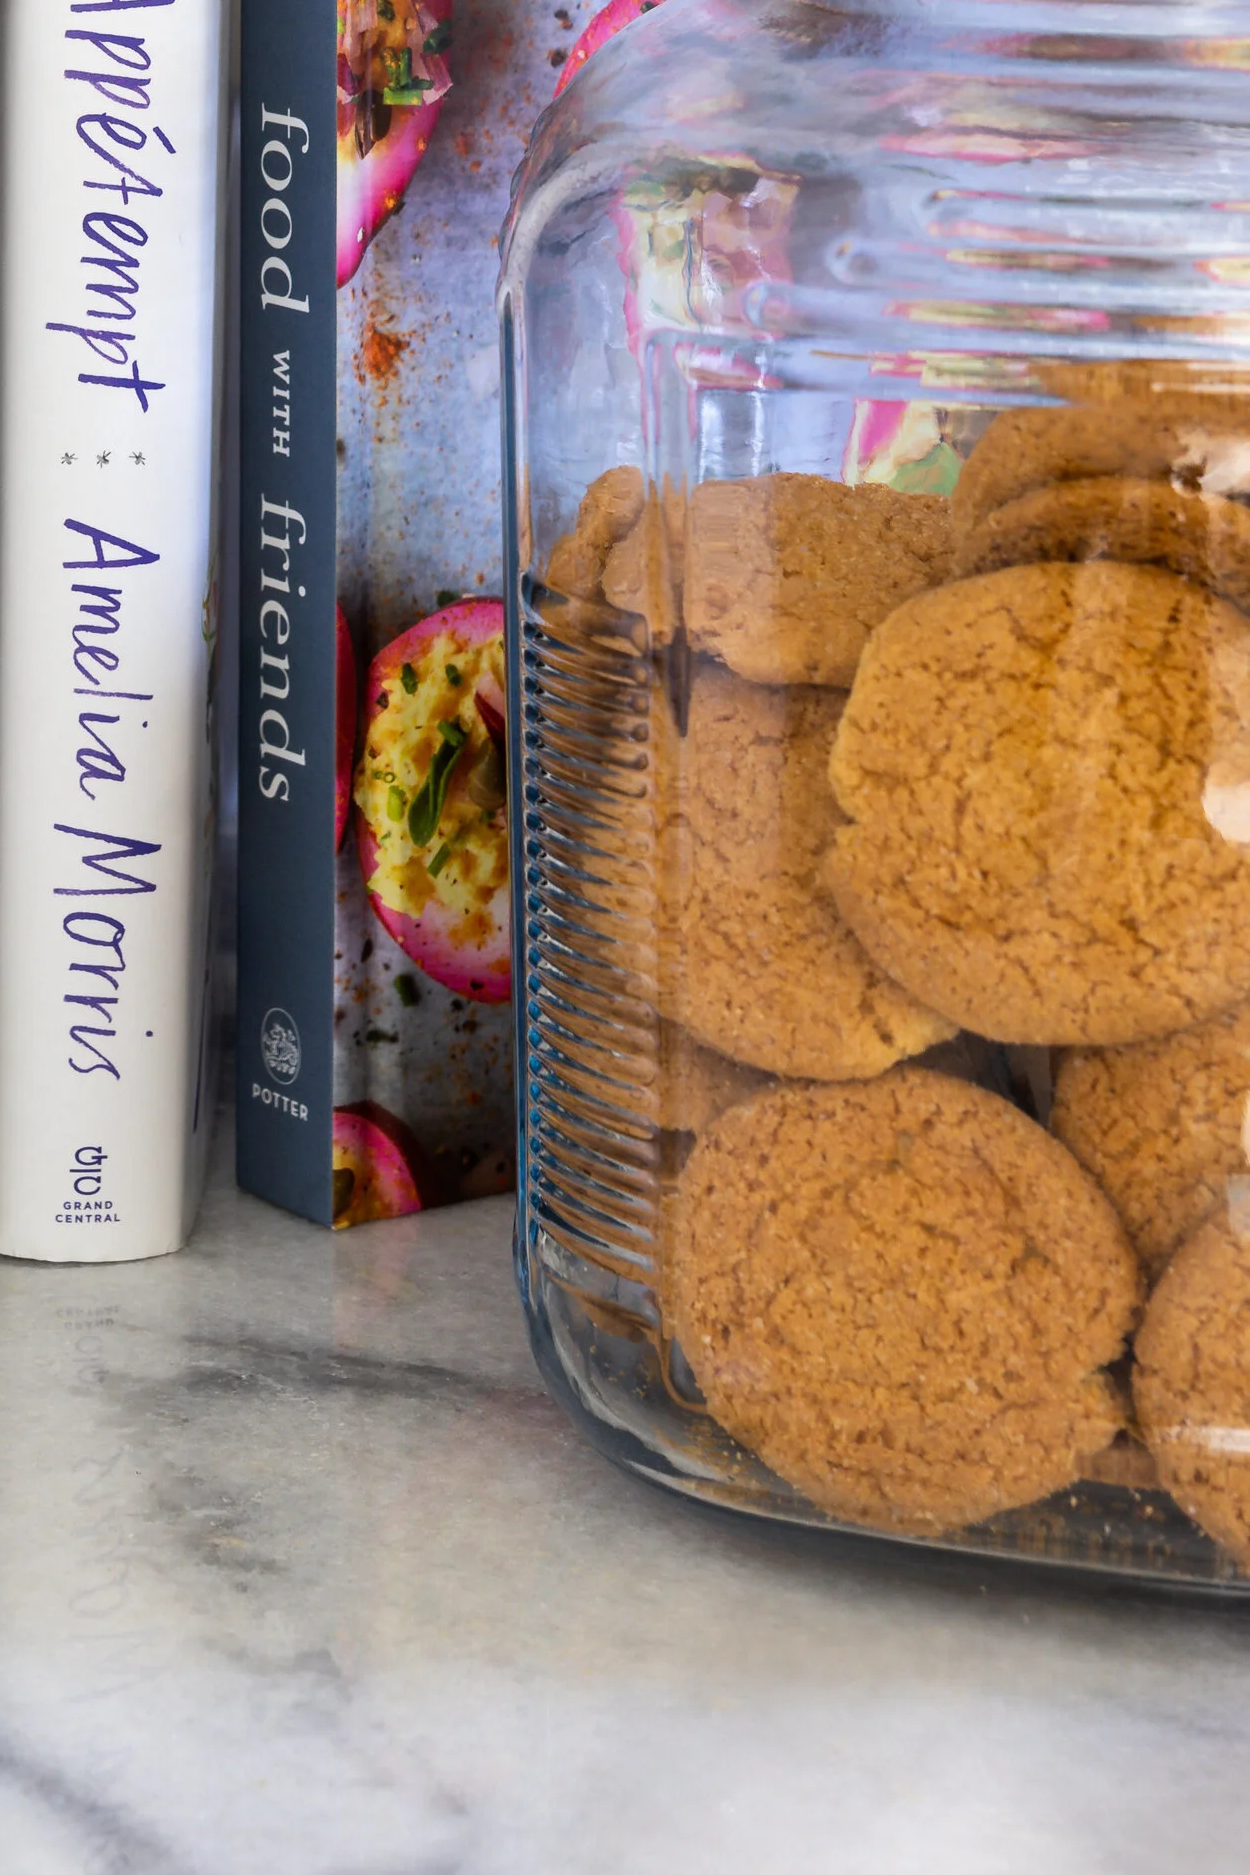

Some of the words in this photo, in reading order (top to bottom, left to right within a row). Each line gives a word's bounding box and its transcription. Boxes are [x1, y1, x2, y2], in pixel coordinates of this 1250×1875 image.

[260, 102, 308, 312] food
[271, 349, 289, 456] WITH
[62, 517, 159, 799] Amelia
[258, 492, 305, 801] friends
[52, 823, 160, 1078] Morris
[252, 1083, 307, 1120] POTTER
[55, 1213, 121, 1223] CENTRAL
[63, 1201, 113, 1210] GRAND
